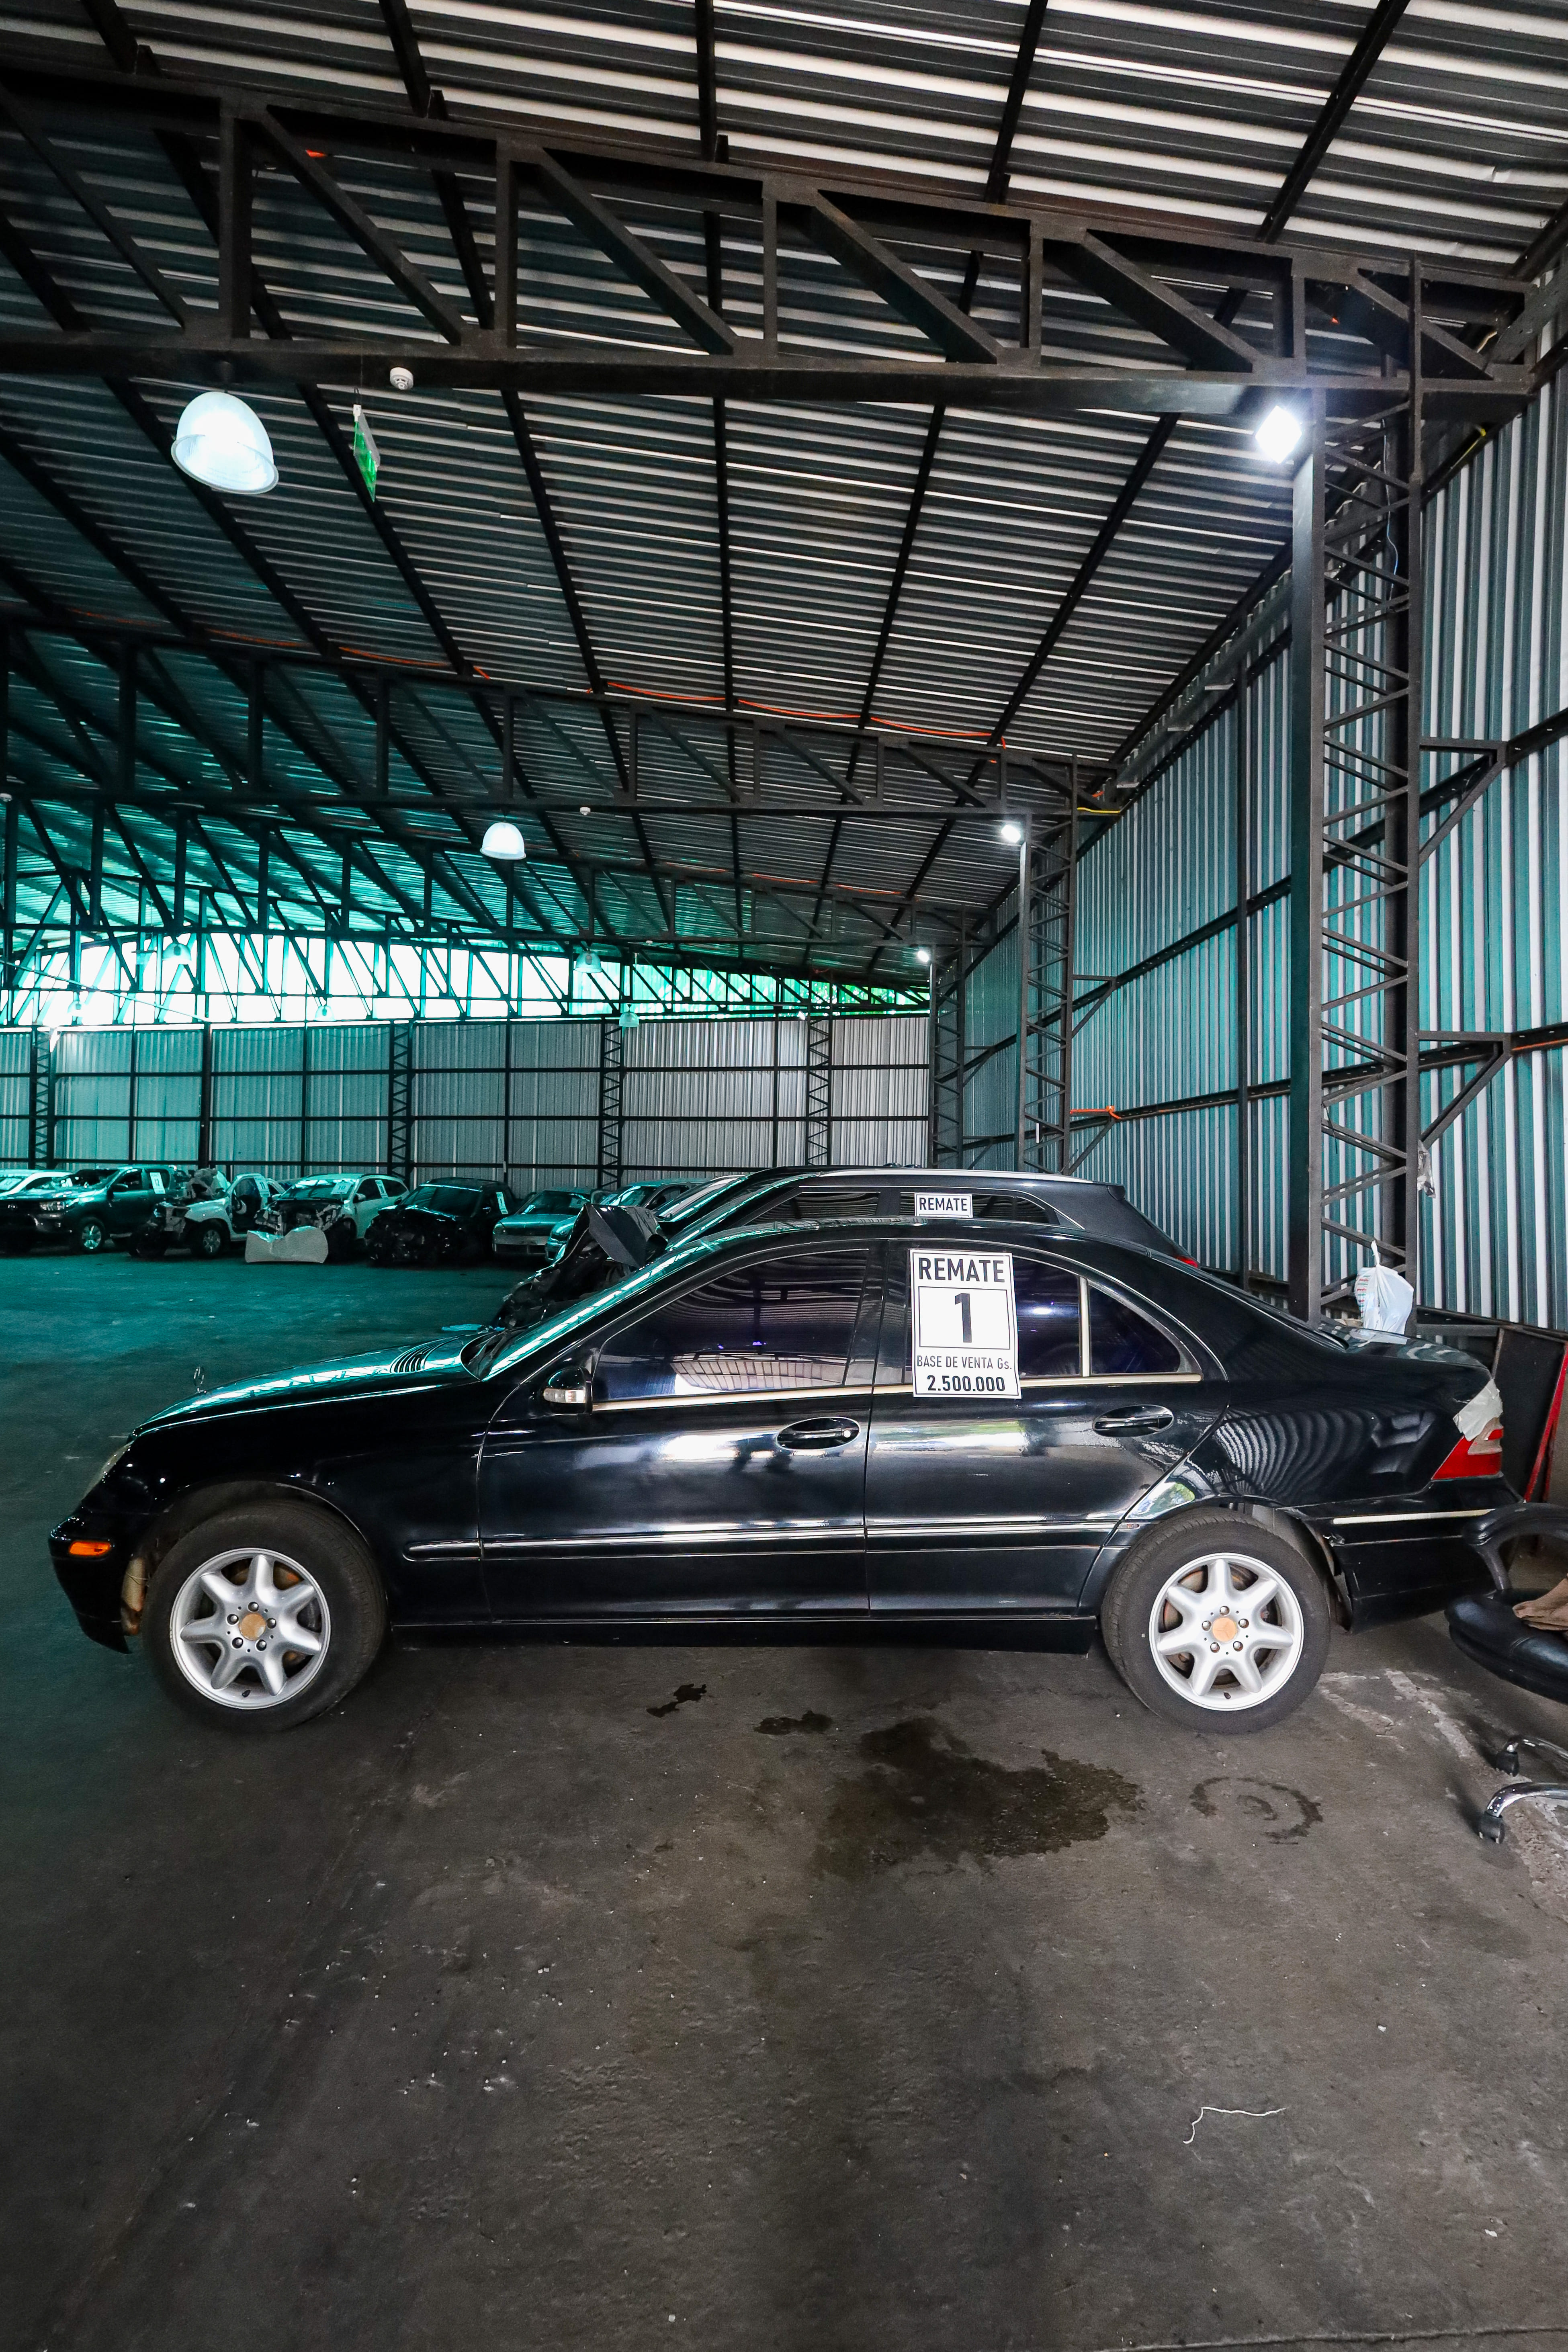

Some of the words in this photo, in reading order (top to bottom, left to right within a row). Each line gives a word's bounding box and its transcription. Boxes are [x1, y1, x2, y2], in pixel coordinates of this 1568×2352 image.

[919, 1197, 967, 1211] REMATE
[919, 1257, 1005, 1282] REMATE
[955, 1293, 972, 1343] 1
[917, 1355, 942, 1367] BASE
[946, 1356, 958, 1367] DE
[962, 1357, 993, 1369] VENTA
[997, 1358, 1012, 1369] Gs.
[927, 1375, 1005, 1392] 2.500.000
